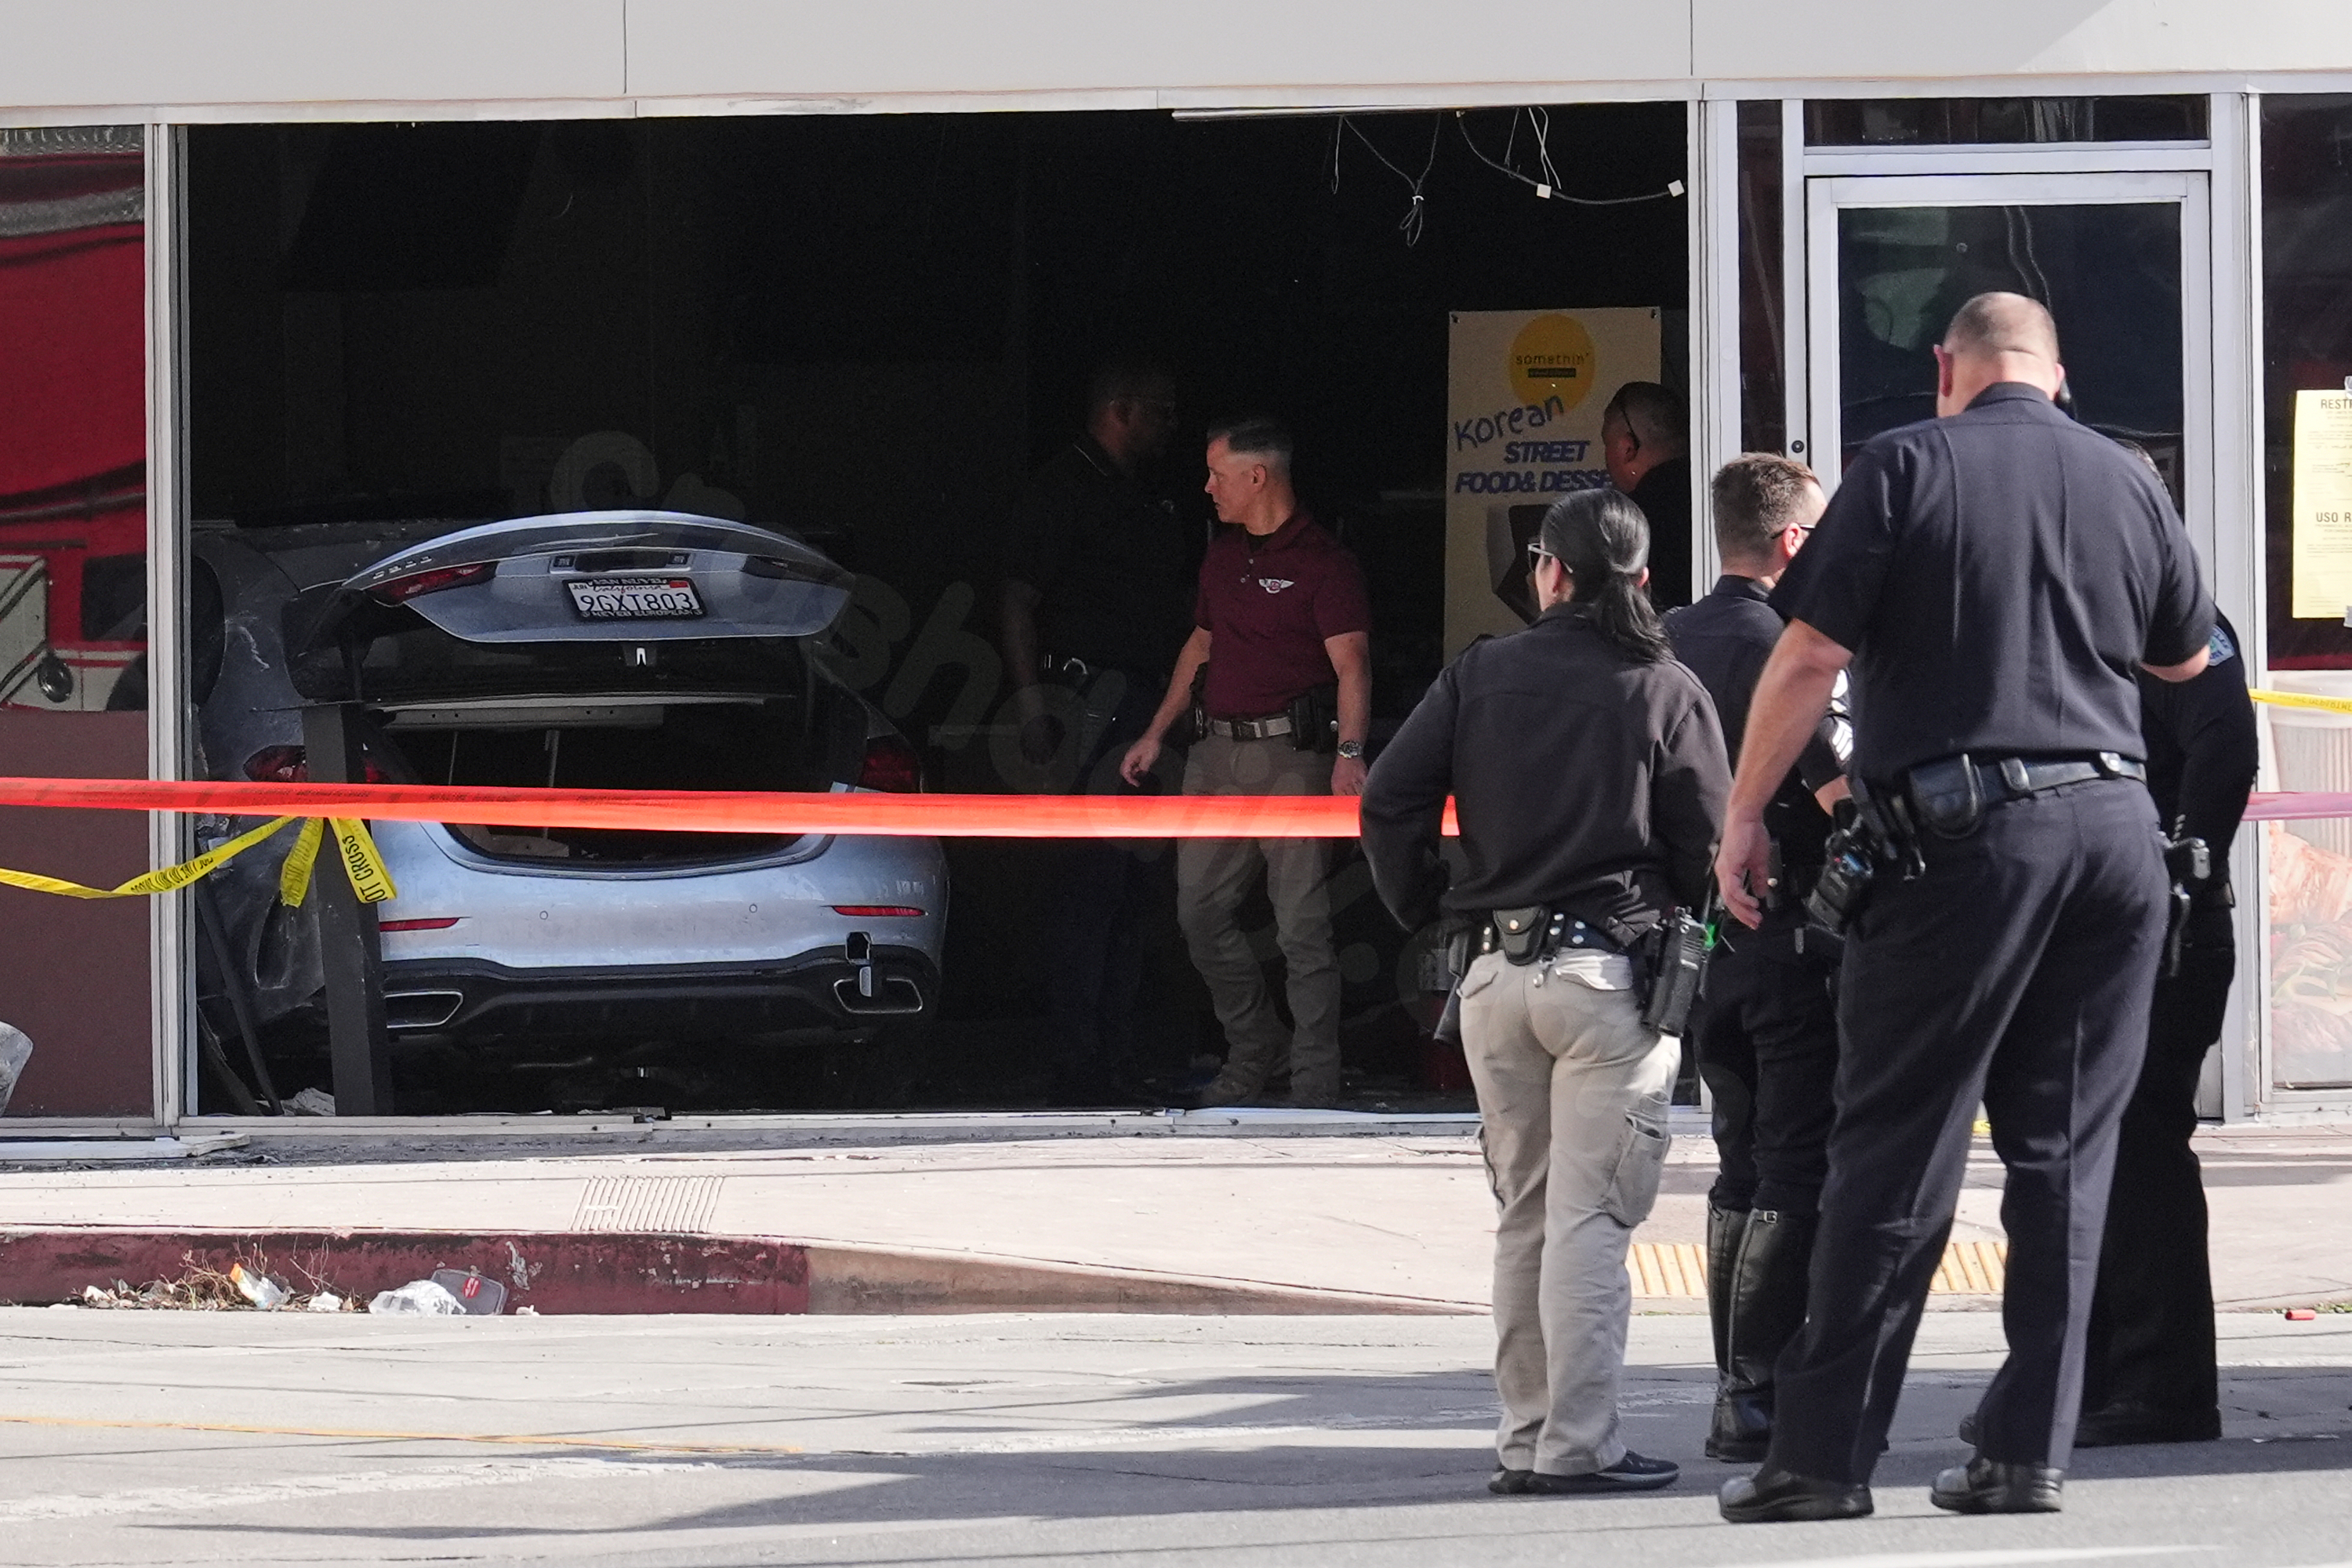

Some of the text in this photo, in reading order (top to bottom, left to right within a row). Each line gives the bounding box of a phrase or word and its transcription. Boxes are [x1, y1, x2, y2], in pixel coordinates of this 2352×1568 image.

[1454, 395, 1564, 451] Korean
[1504, 441, 1590, 463] STREET
[2315, 511, 2339, 523] USO
[580, 592, 694, 612] 9GXT803
[342, 835, 374, 881] CROSS
